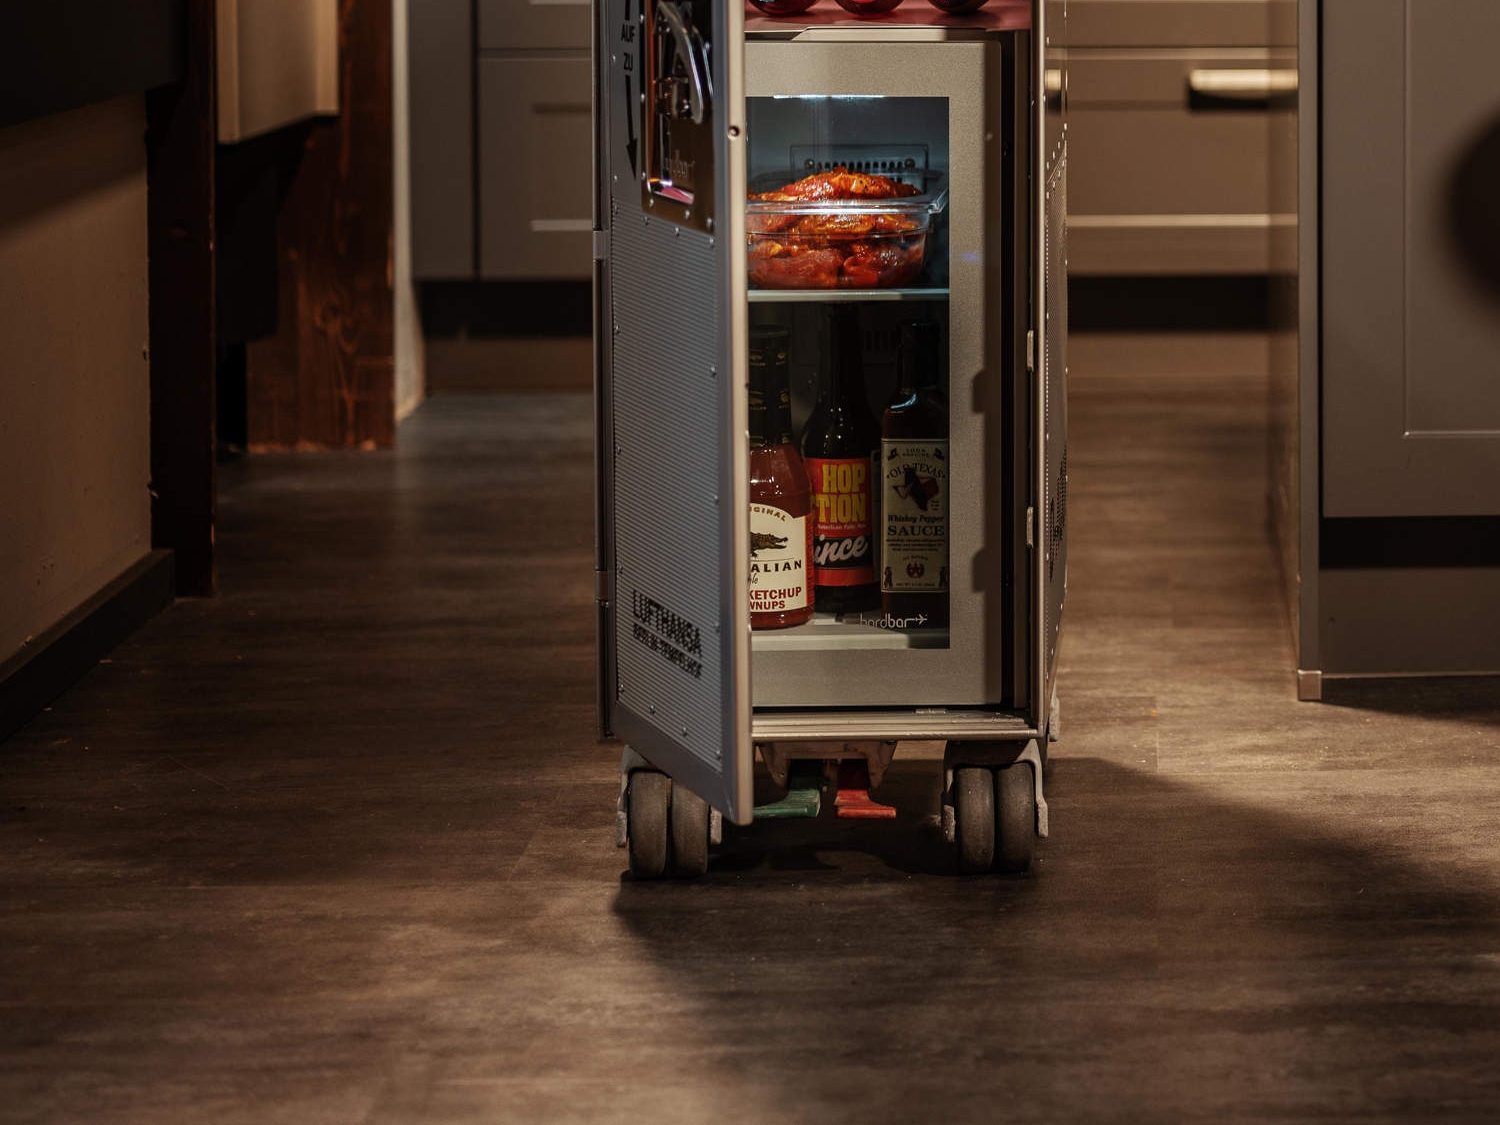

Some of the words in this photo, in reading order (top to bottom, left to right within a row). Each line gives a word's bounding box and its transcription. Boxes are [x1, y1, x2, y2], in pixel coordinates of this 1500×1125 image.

[621, 23, 635, 43] AUF
[623, 52, 633, 72] ZU
[822, 463, 866, 493] HOP
[889, 464, 910, 478] OLD
[912, 462, 943, 478] TEXAS
[888, 514, 917, 524] Whiskey
[919, 515, 944, 524] Pepper
[887, 525, 945, 536] SAUCE
[750, 587, 802, 600] KETCHUP
[633, 589, 702, 658] LUFTHANSA
[860, 613, 915, 629] bordbar
